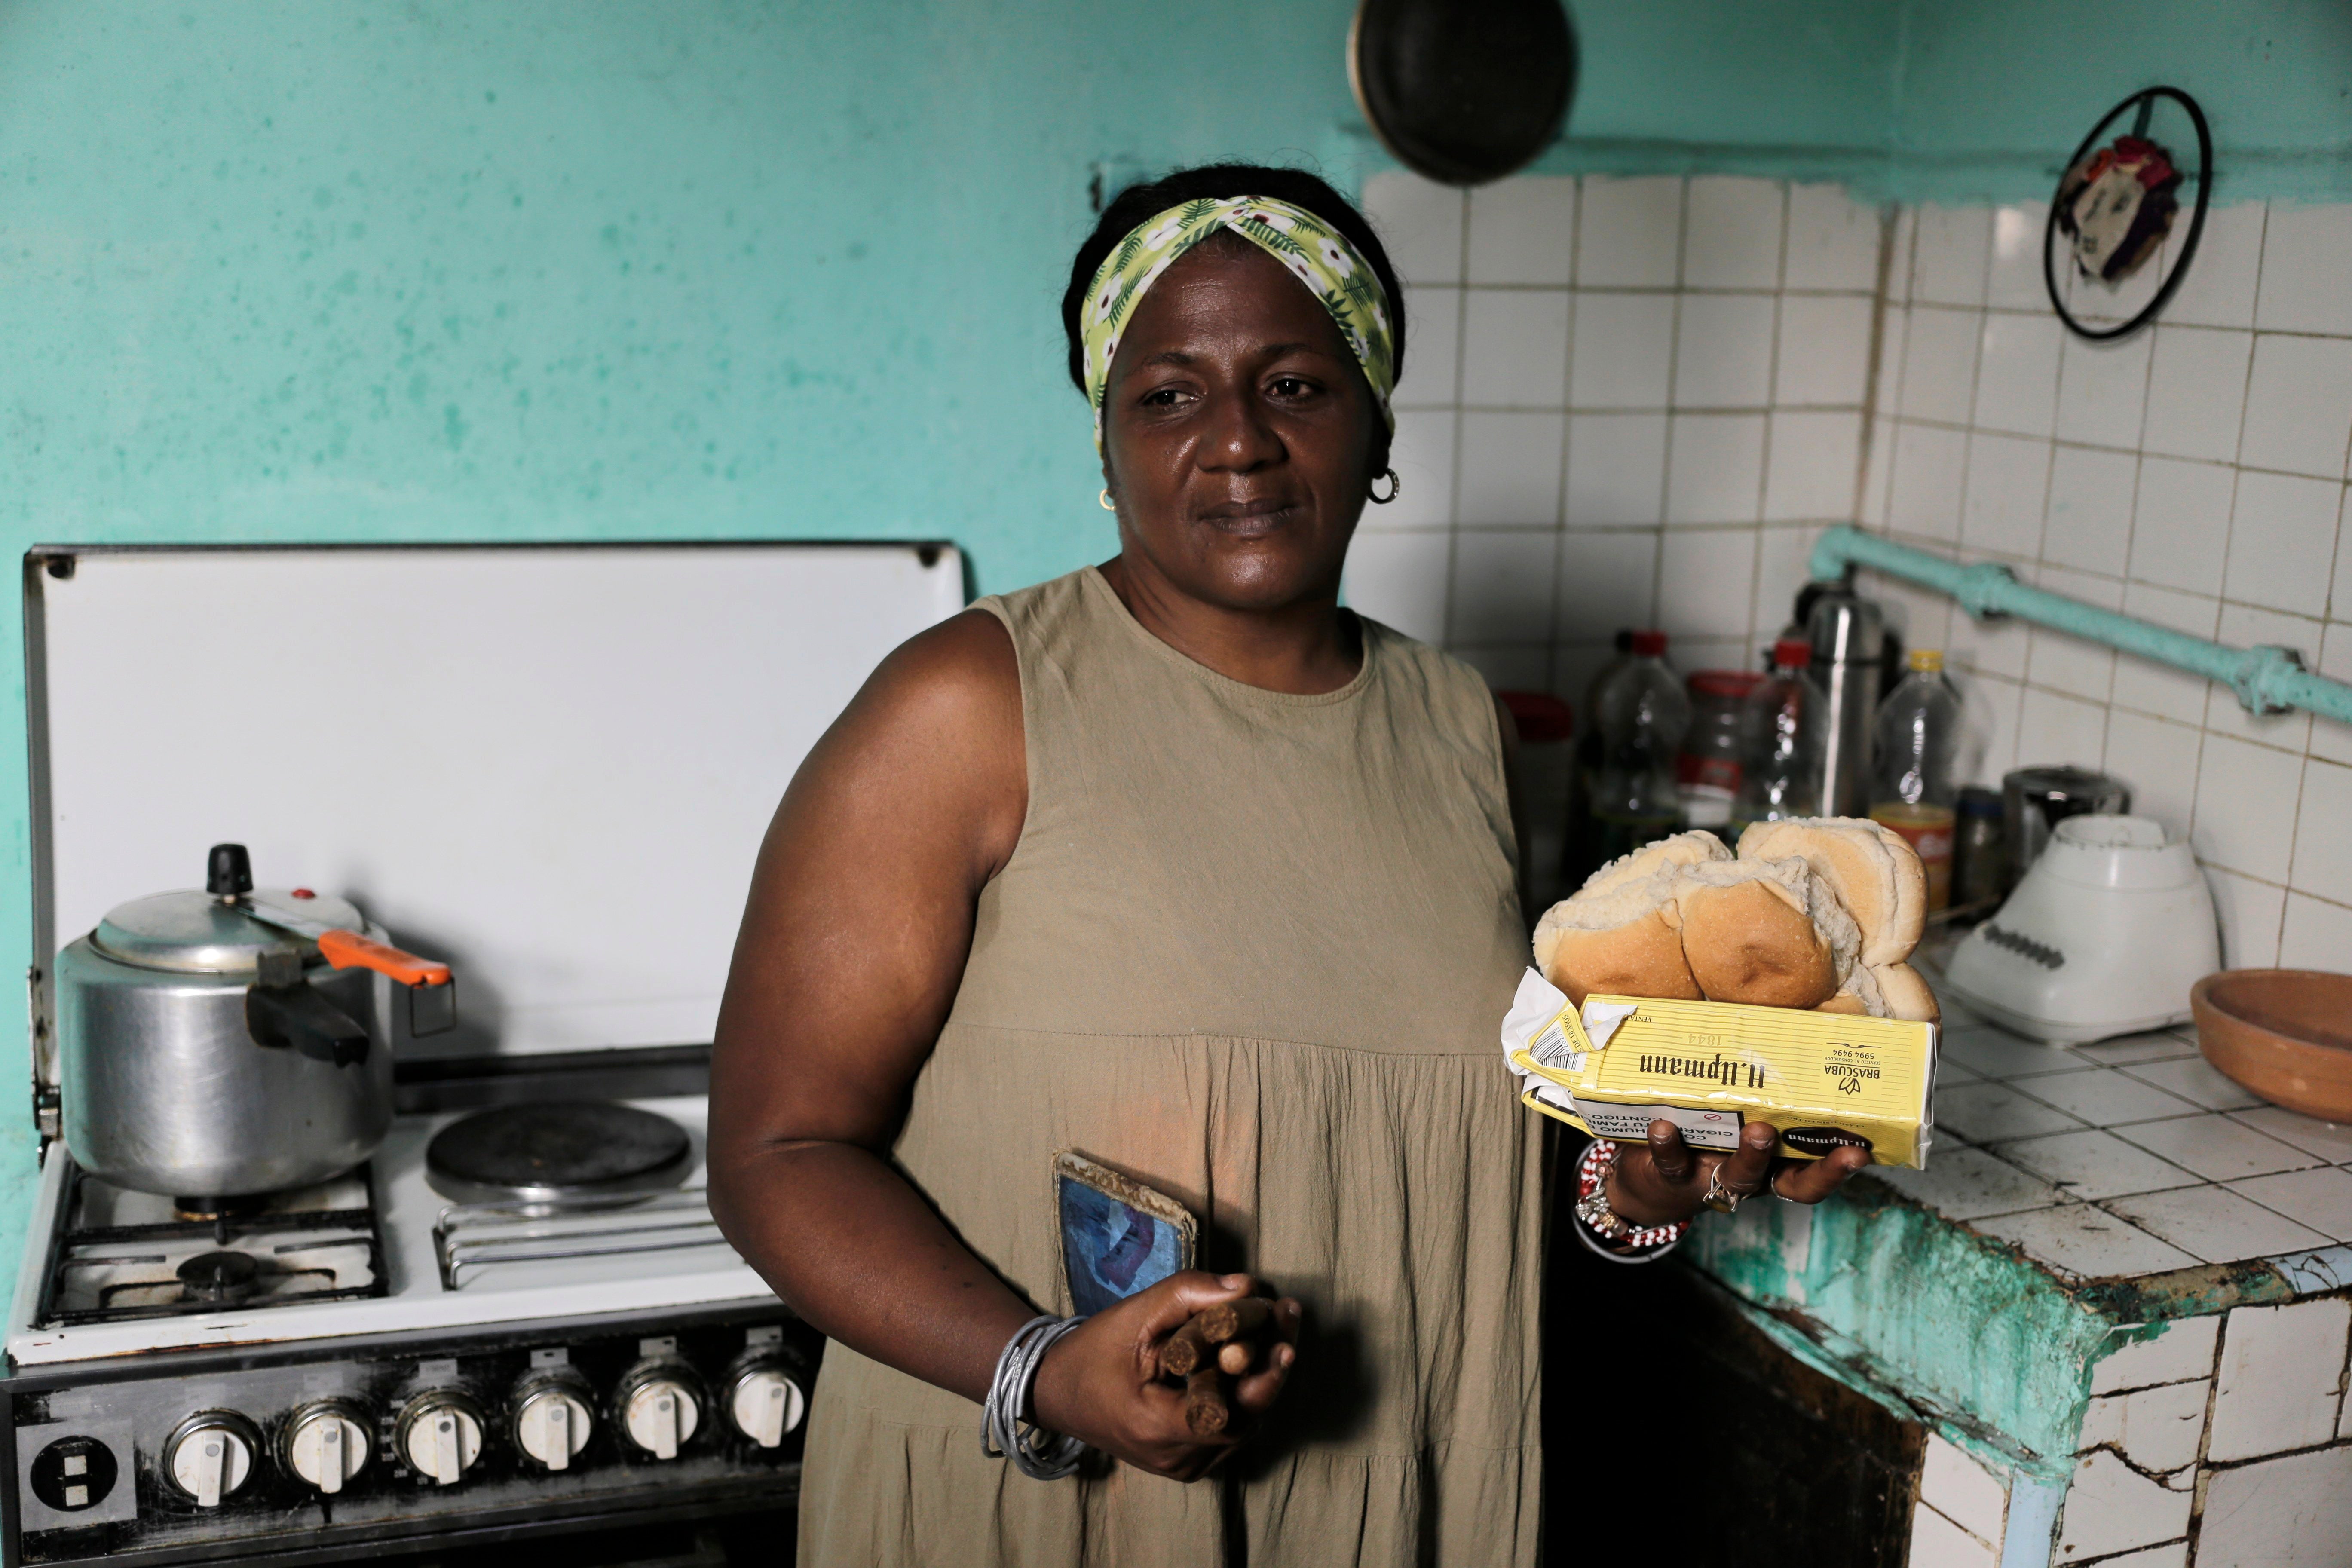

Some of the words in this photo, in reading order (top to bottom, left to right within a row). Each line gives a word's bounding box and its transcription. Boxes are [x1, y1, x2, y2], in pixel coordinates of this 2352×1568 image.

[1562, 1014, 1571, 1030] AÑOS
[1556, 1029, 1571, 1054] 720271
[1573, 1039, 1580, 1048] DE
[1688, 1033, 1722, 1046] 1844
[1824, 1065, 1880, 1079] BRASCUBA
